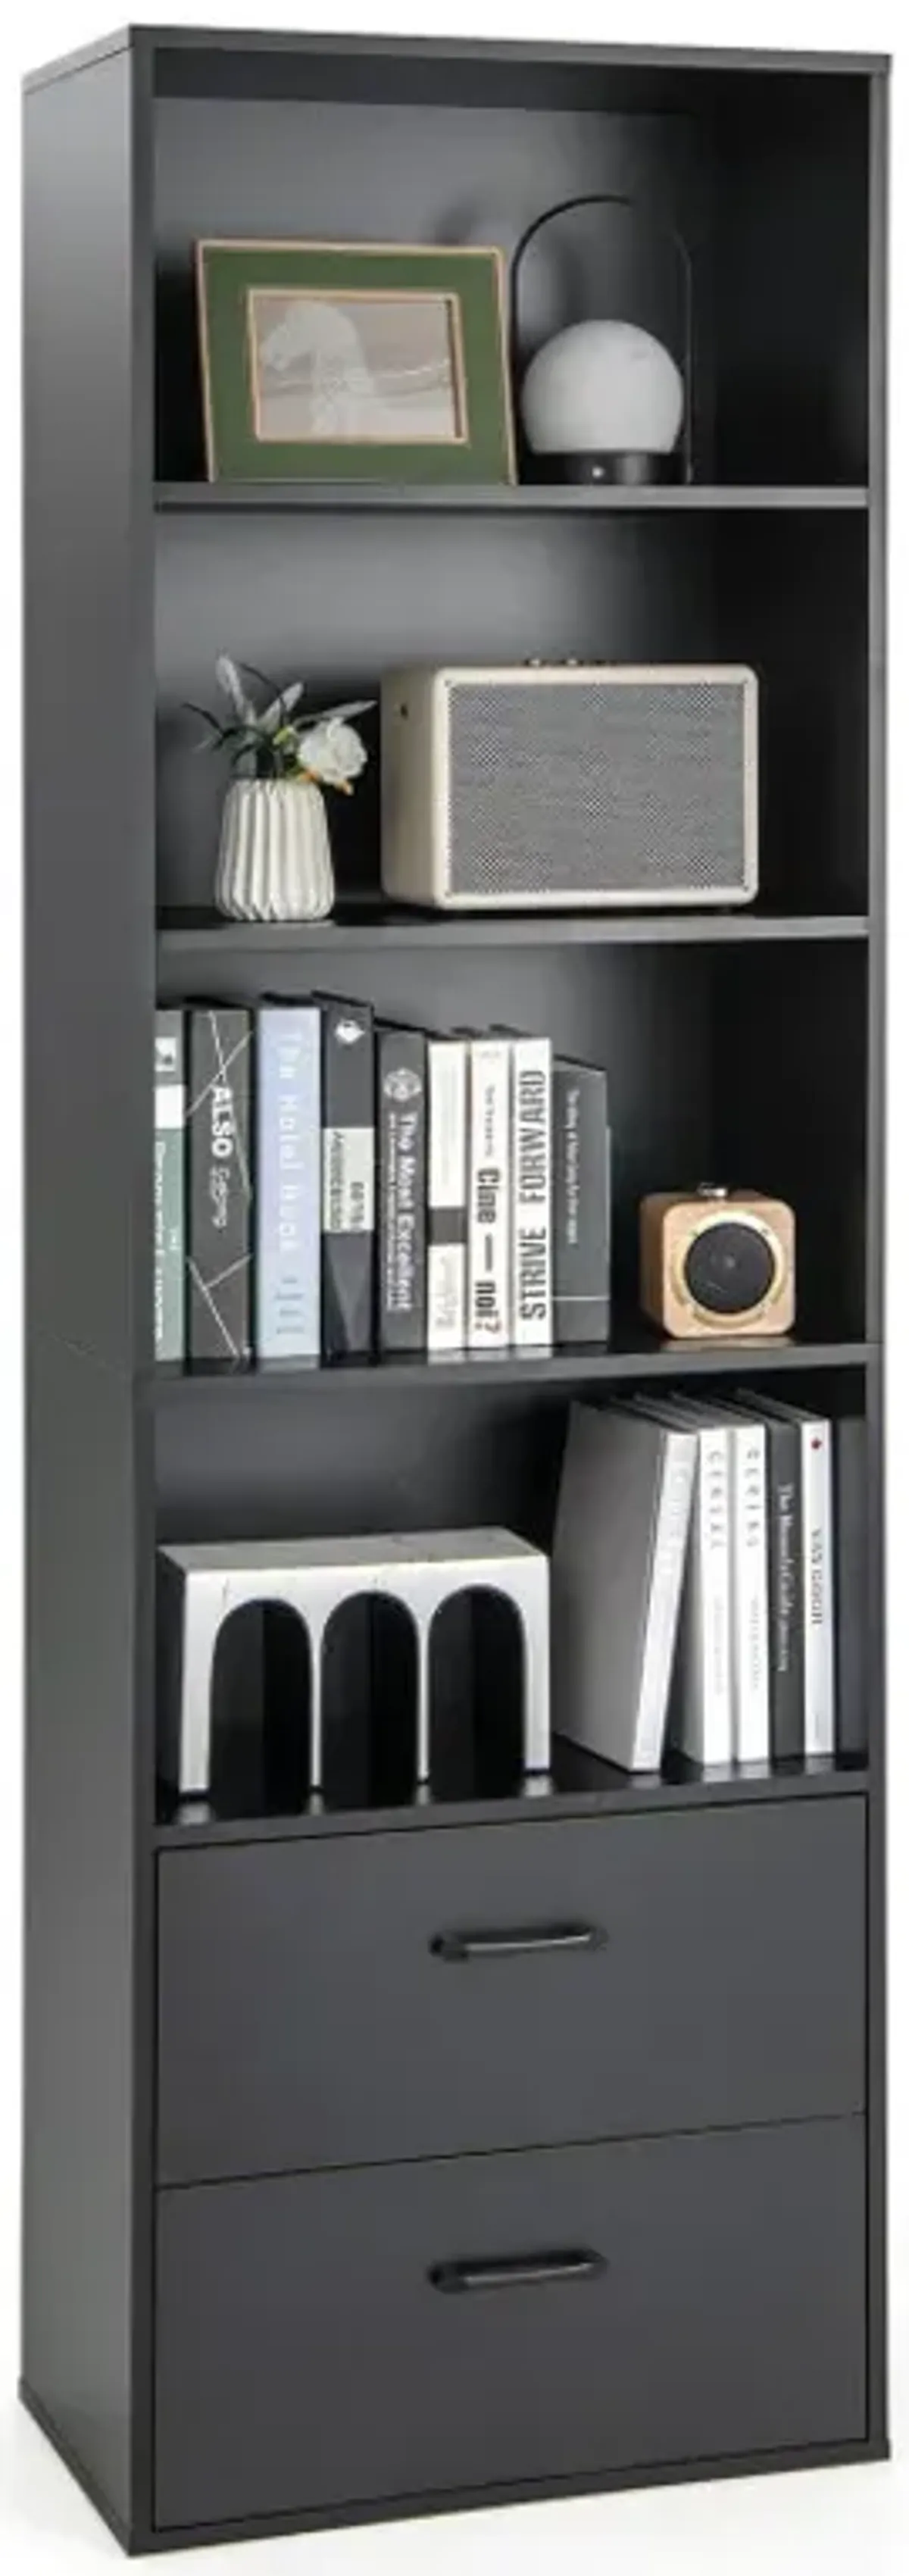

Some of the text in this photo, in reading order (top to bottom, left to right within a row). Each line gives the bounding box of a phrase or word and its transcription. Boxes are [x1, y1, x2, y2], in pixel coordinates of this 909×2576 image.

[279, 1033, 300, 1079] The
[211, 1086, 234, 1158] ALSO
[397, 1112, 417, 1311] The Most Excellent
[476, 1167, 501, 1224] Cine
[519, 1070, 547, 1321] STRIVE FORWARD
